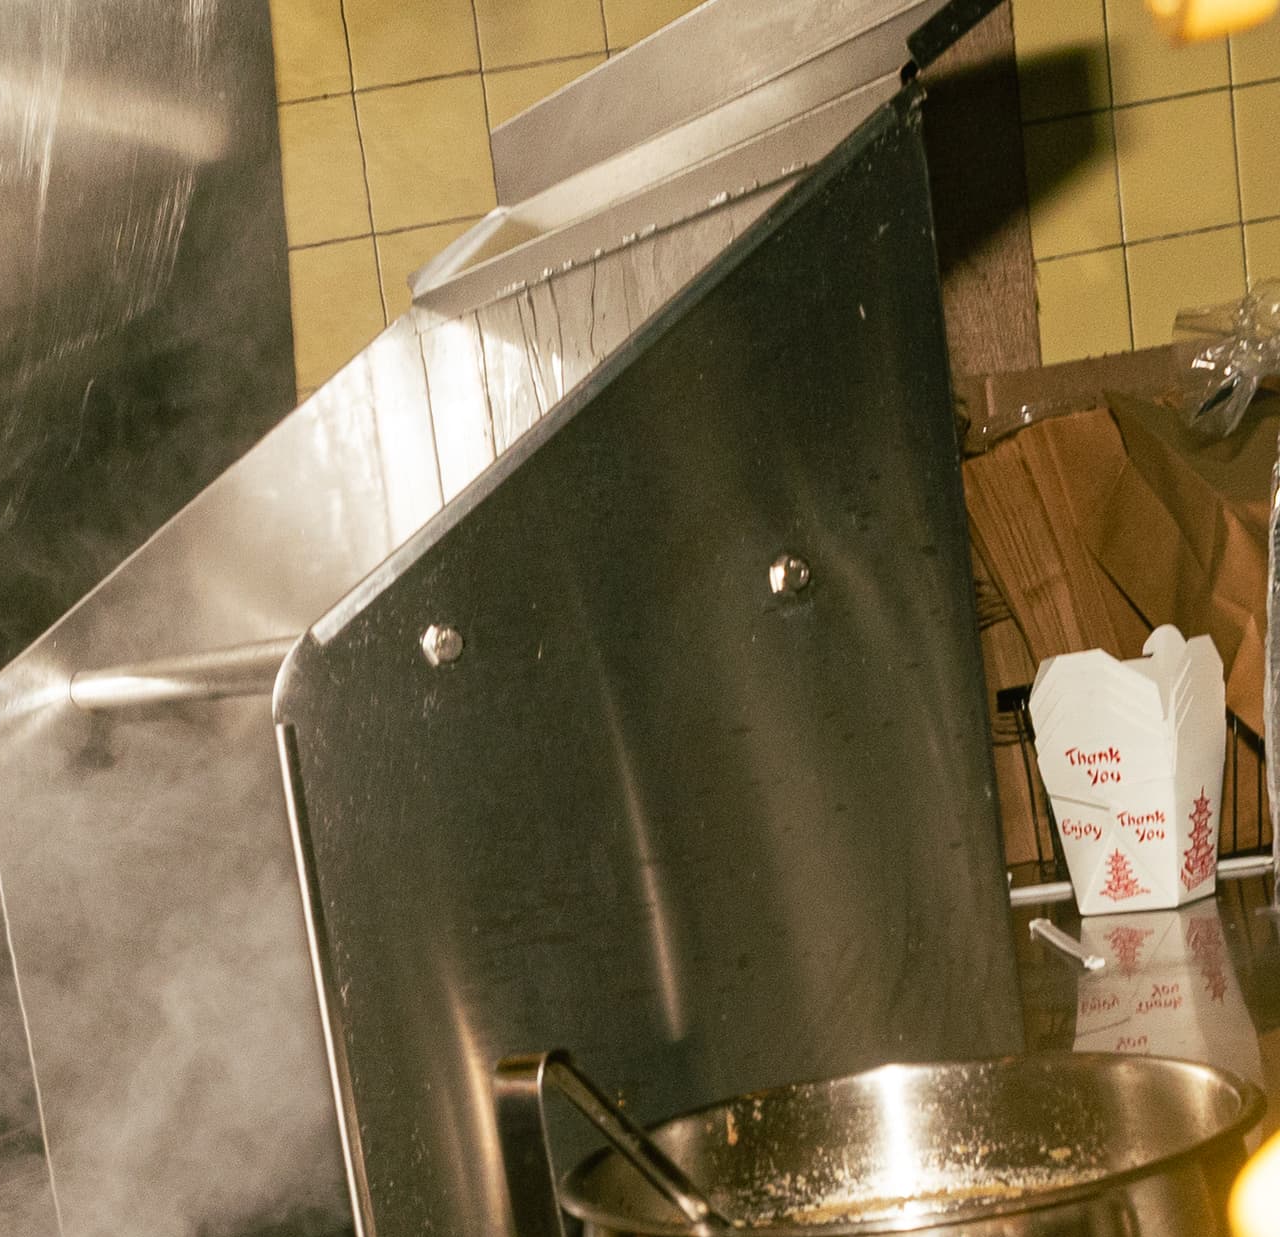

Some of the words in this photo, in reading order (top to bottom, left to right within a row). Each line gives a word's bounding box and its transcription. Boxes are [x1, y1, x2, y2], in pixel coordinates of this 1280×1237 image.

[1065, 747, 1121, 766] Thank
[1087, 768, 1121, 786] You
[1117, 810, 1165, 827] Thank
[1062, 819, 1102, 840] Enjoy
[1136, 828, 1165, 842] You
